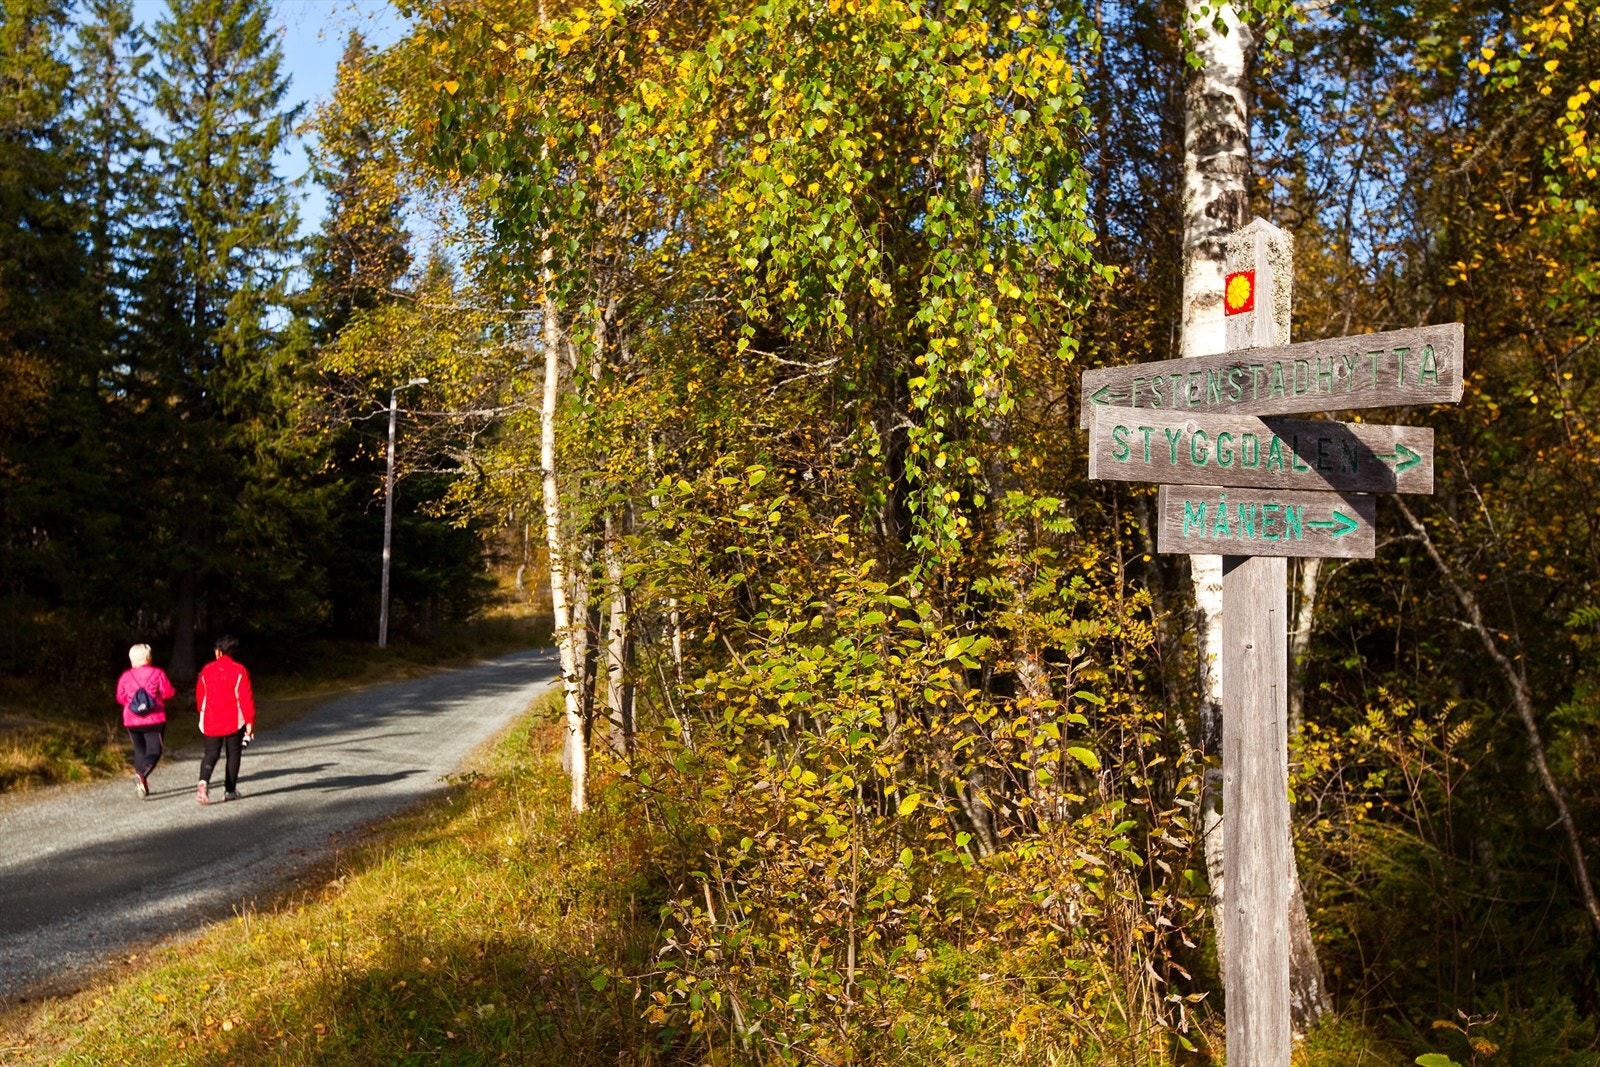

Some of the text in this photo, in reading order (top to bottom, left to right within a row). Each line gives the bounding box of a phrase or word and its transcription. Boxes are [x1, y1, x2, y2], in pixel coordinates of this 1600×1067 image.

[1131, 343, 1439, 408] ESTENSTADHYTTA
[1112, 424, 1360, 474] STYGGDALEN
[1183, 493, 1304, 541] MÅNEN
